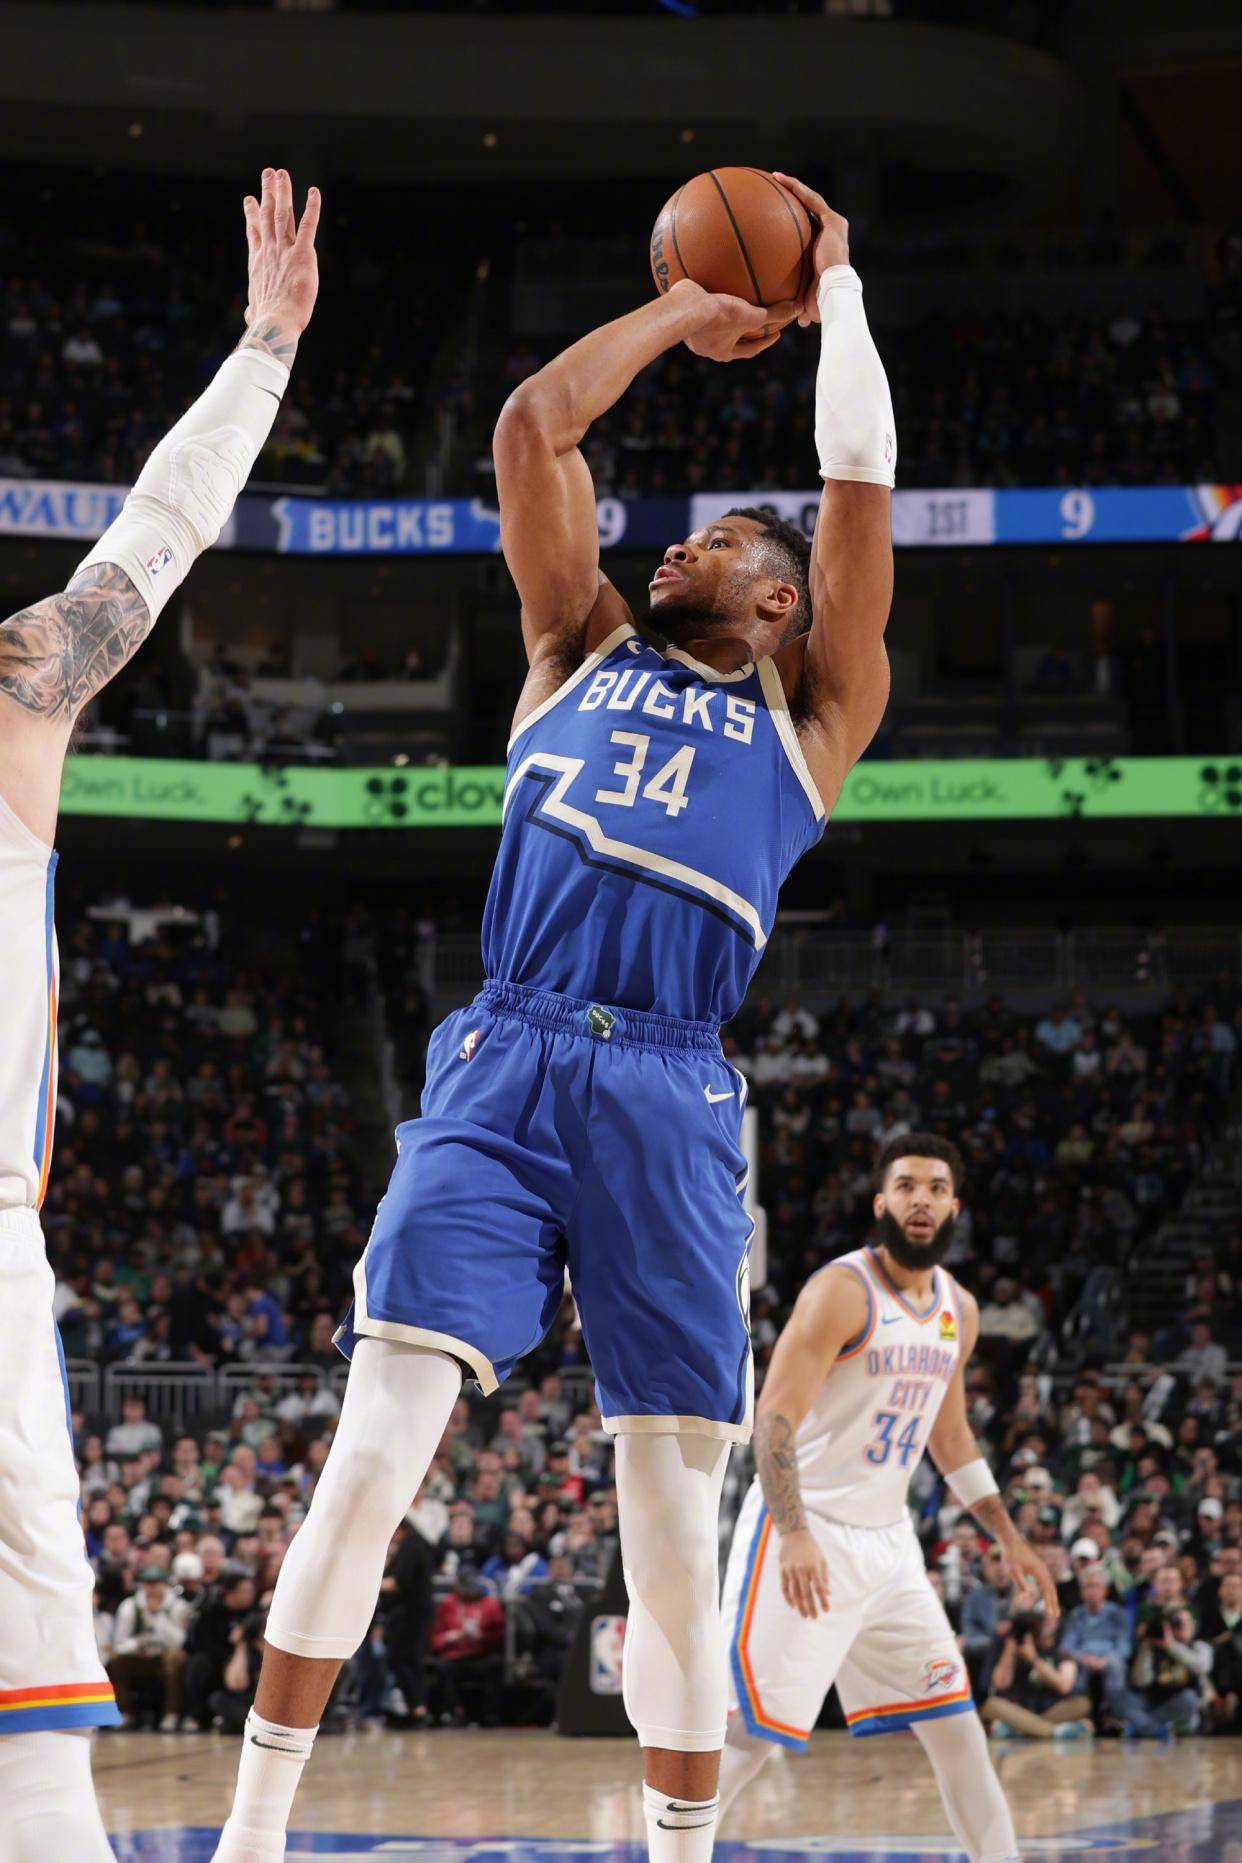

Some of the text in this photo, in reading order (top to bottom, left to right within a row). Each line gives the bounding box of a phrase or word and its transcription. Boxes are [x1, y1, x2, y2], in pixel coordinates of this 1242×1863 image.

[309, 504, 454, 551] BUCKS
[596, 498, 627, 548] 9
[1060, 489, 1095, 540] 9
[578, 669, 757, 745] BUCKS
[595, 730, 696, 817] 34
[850, 776, 924, 805] Own
[887, 1379, 934, 1411] CITY
[863, 1408, 926, 1472] 34
